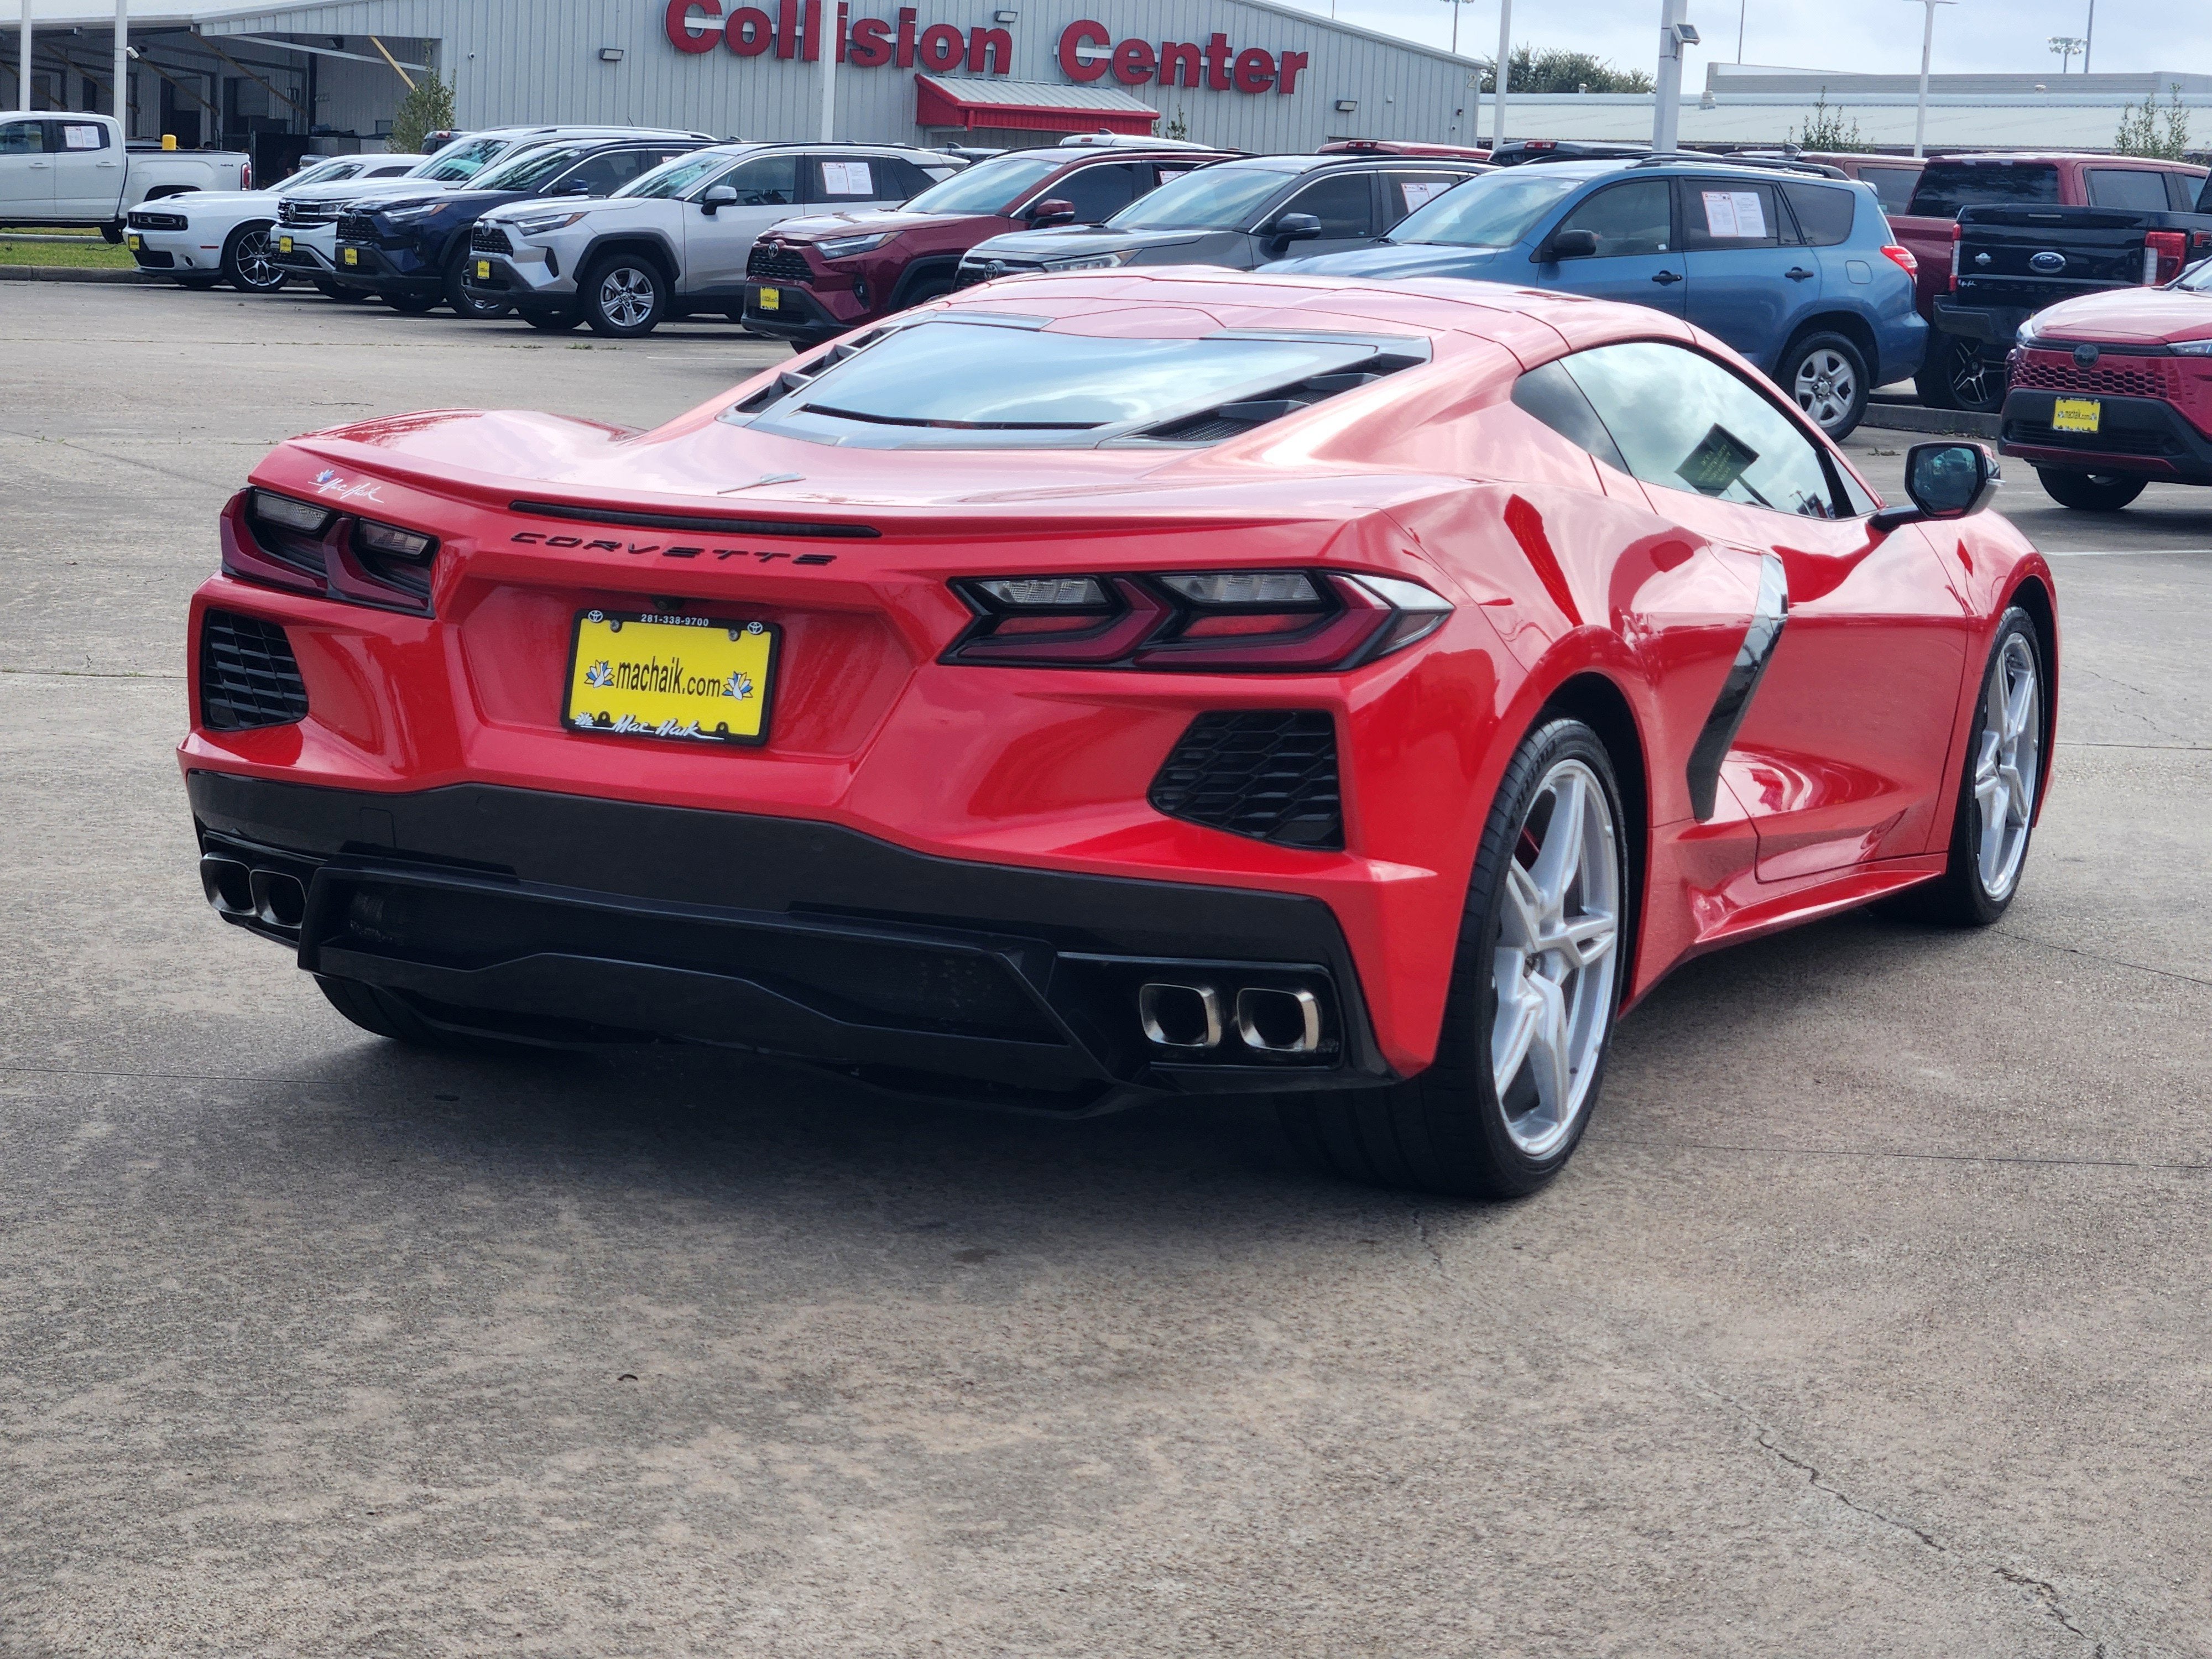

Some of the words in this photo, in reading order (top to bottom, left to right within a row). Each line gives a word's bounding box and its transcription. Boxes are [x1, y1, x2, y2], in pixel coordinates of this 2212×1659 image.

[666, 0, 1012, 74] Collision
[1058, 19, 1308, 94] Center
[1467, 74, 1477, 88] 2
[510, 532, 837, 566] CORVETTE
[640, 613, 709, 627] 281-338-9700
[615, 655, 720, 698] machaik.com
[607, 713, 655, 734] Mac
[655, 718, 724, 740] Haik
